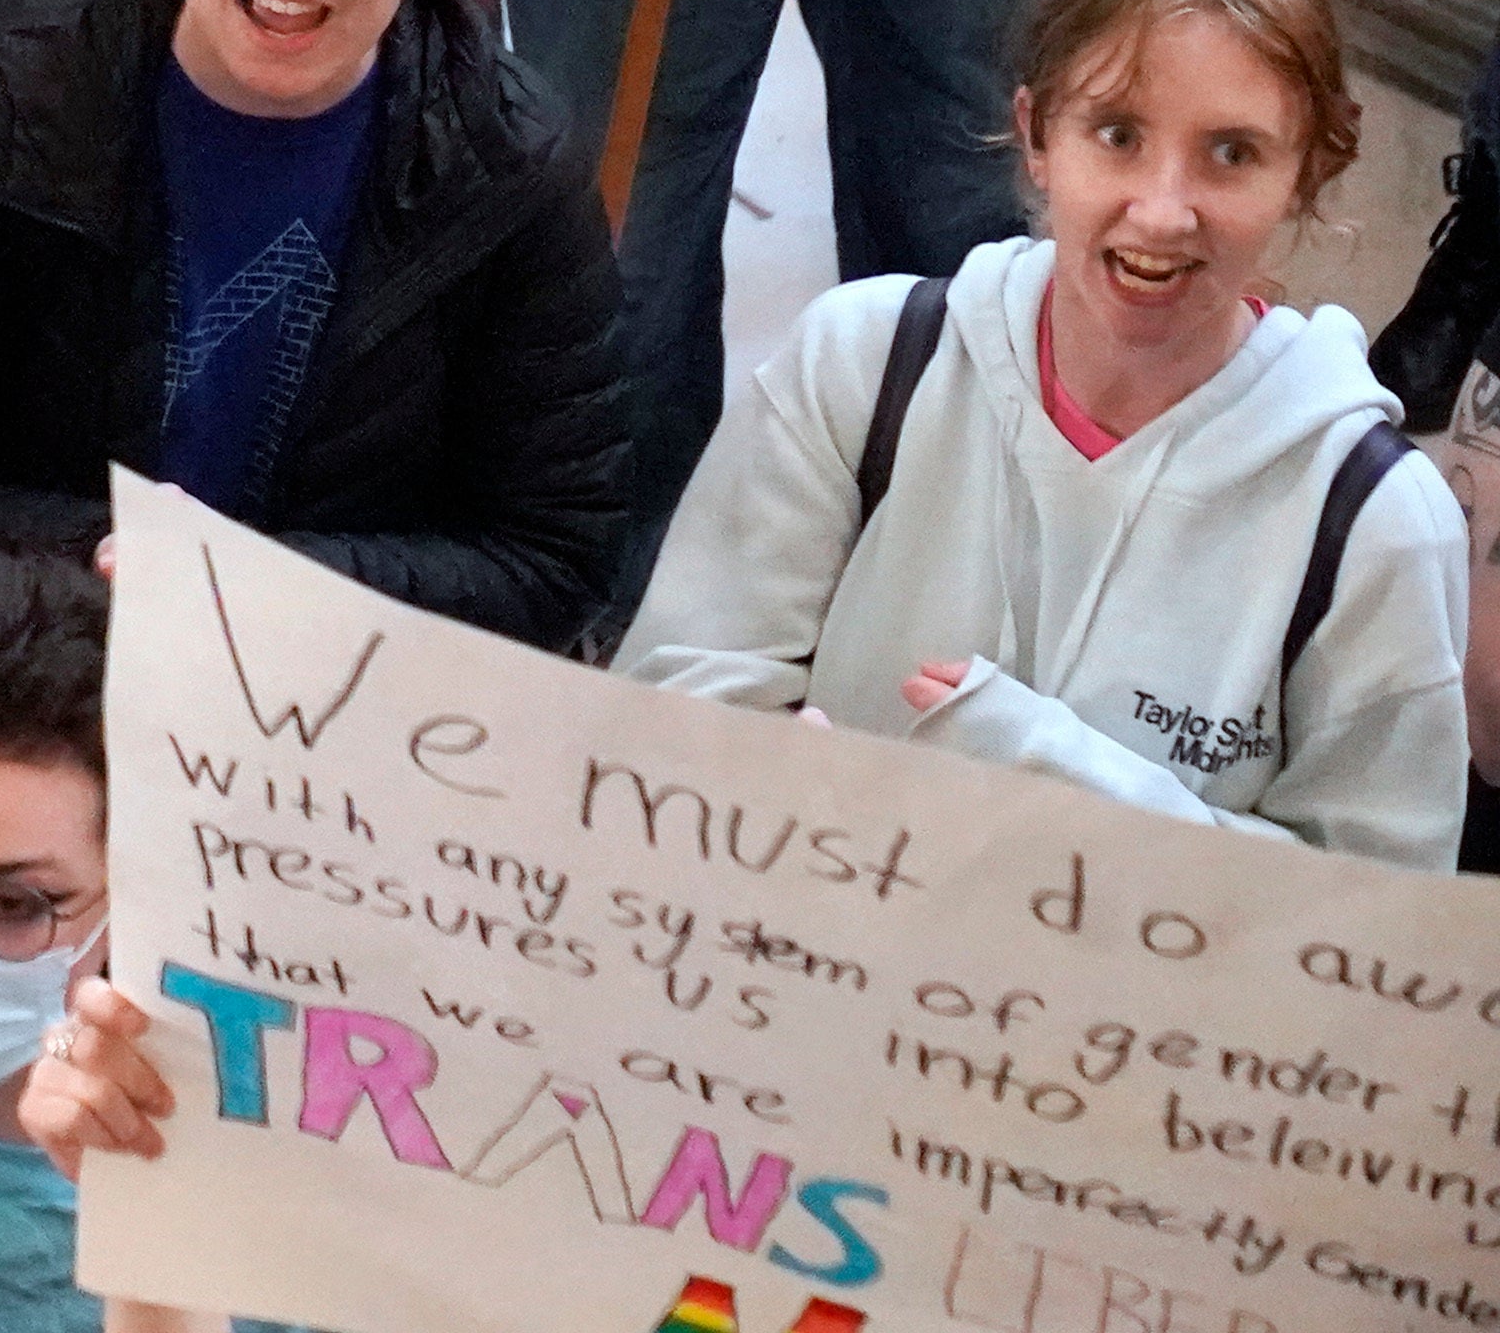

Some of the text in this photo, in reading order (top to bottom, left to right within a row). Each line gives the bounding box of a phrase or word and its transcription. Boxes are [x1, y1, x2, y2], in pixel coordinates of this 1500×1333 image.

[200, 542, 507, 800] We
[580, 756, 927, 901] must
[1029, 851, 1207, 961] do
[192, 907, 357, 998] that
[420, 985, 539, 1049] we
[619, 1046, 793, 1125] are
[437, 837, 570, 922] any
[914, 979, 1045, 1034] of
[1072, 1019, 1402, 1113] gender
[885, 1030, 1087, 1124] into
[160, 959, 891, 1290] TRANS
